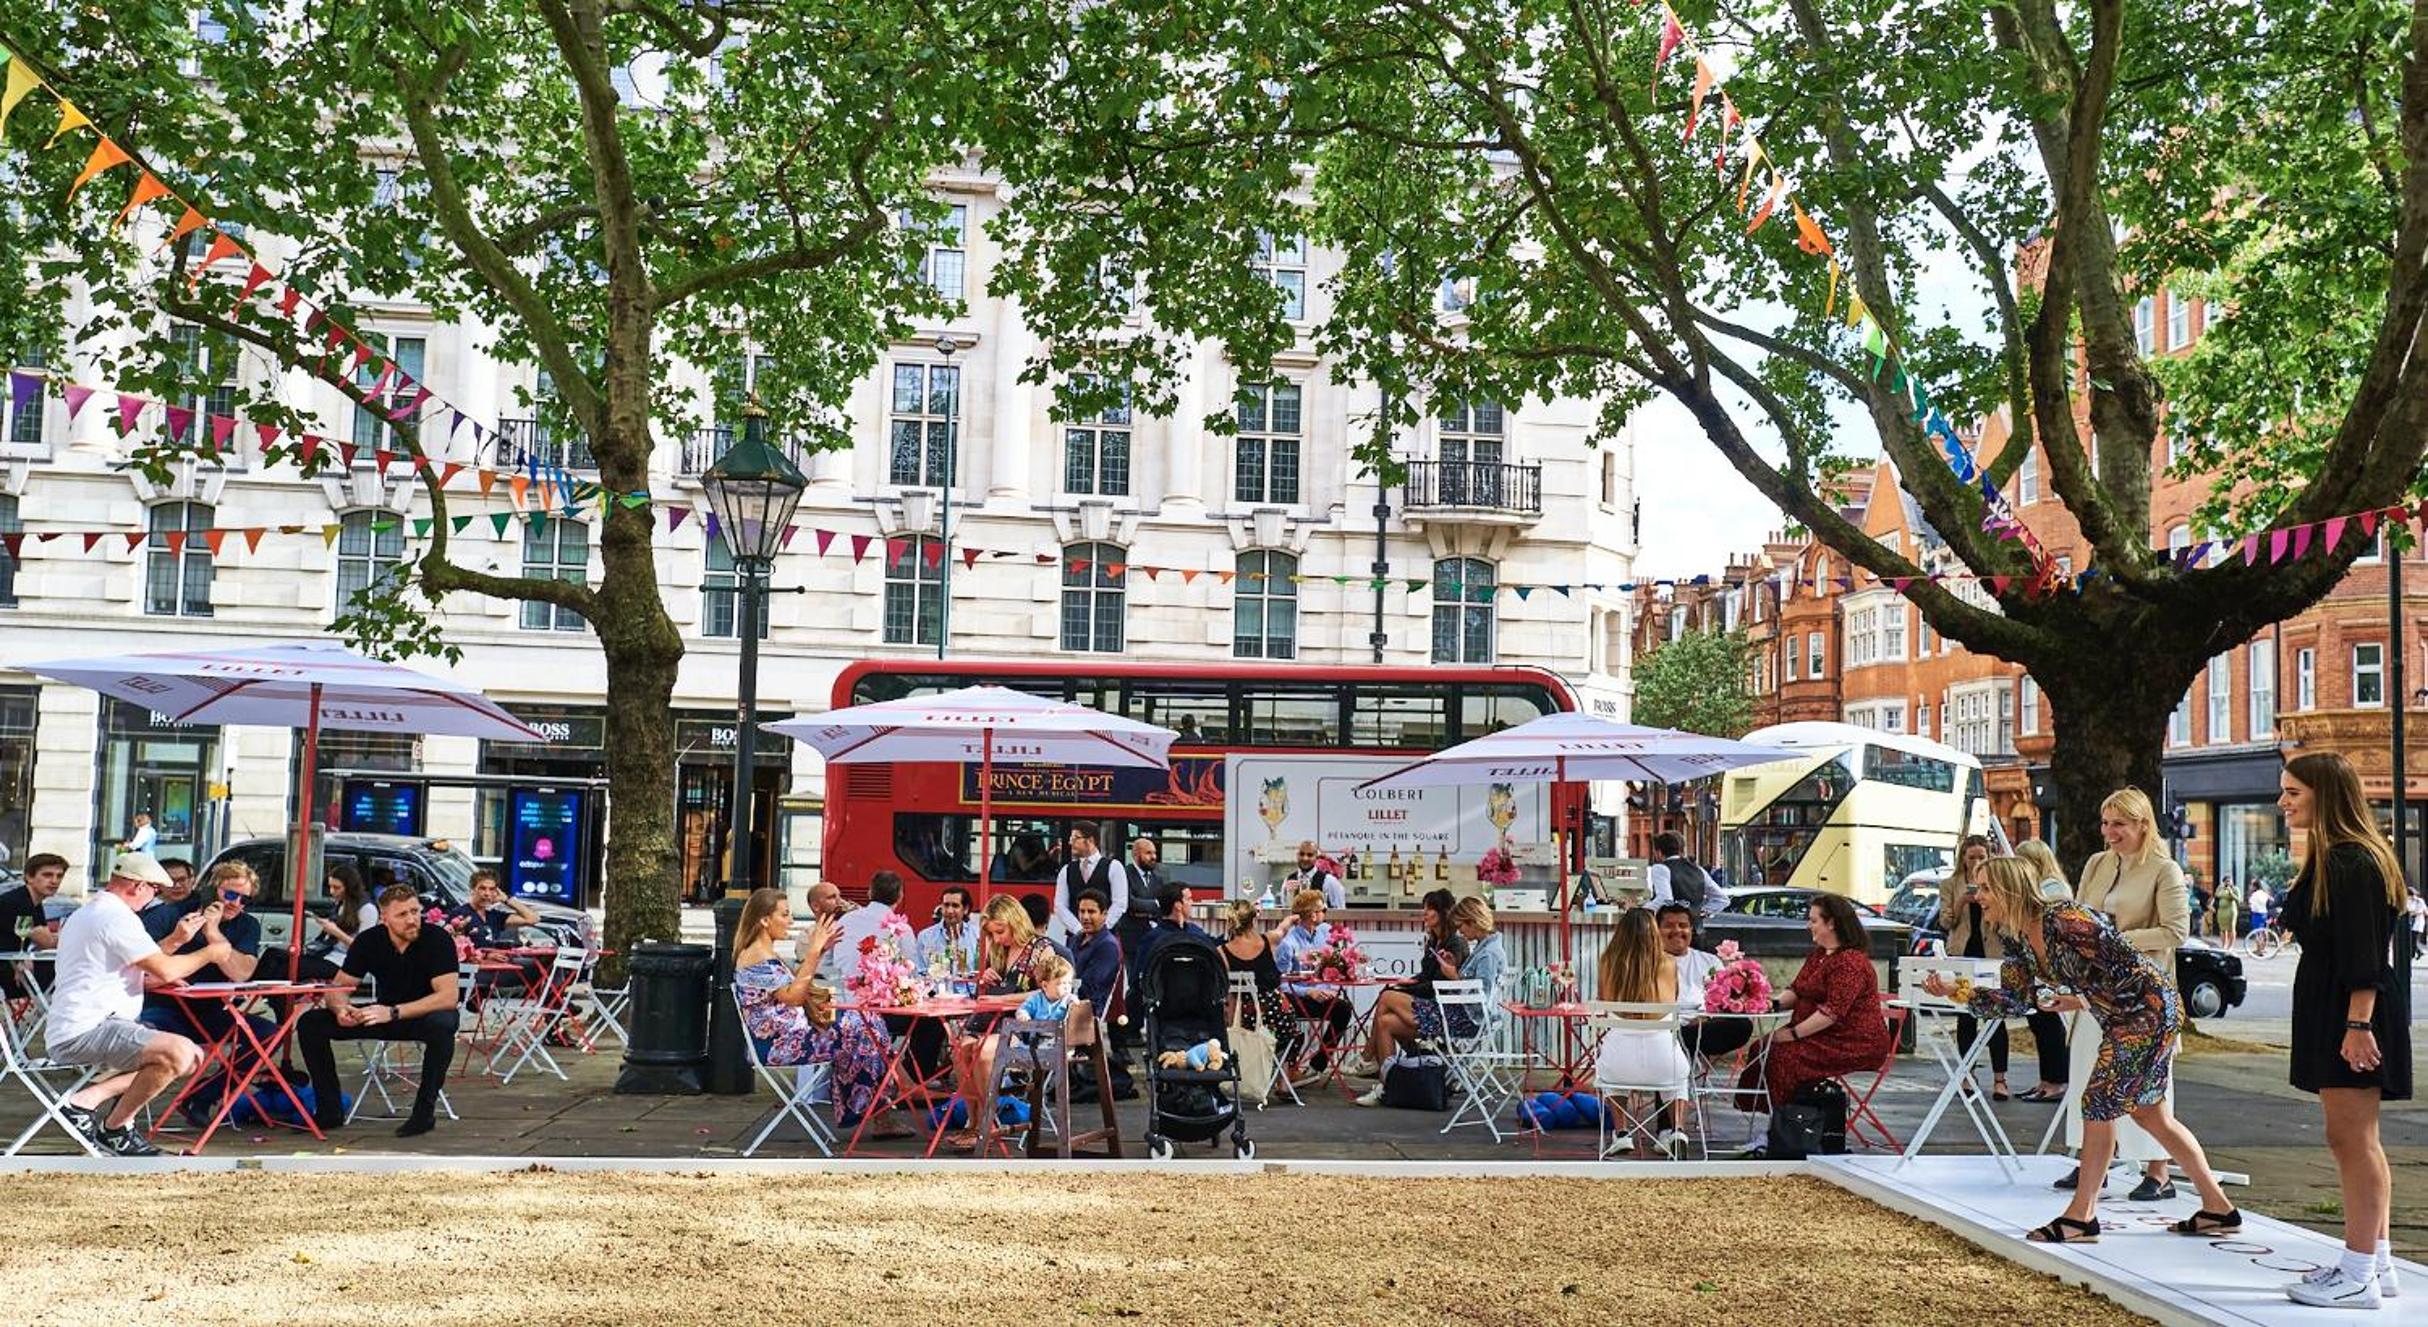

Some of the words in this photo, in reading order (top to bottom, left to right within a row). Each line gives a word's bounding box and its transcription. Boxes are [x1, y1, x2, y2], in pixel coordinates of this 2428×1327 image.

[712, 728, 737, 741] BO
[1353, 788, 1424, 801] COLBERT
[1368, 809, 1408, 820] LILLET
